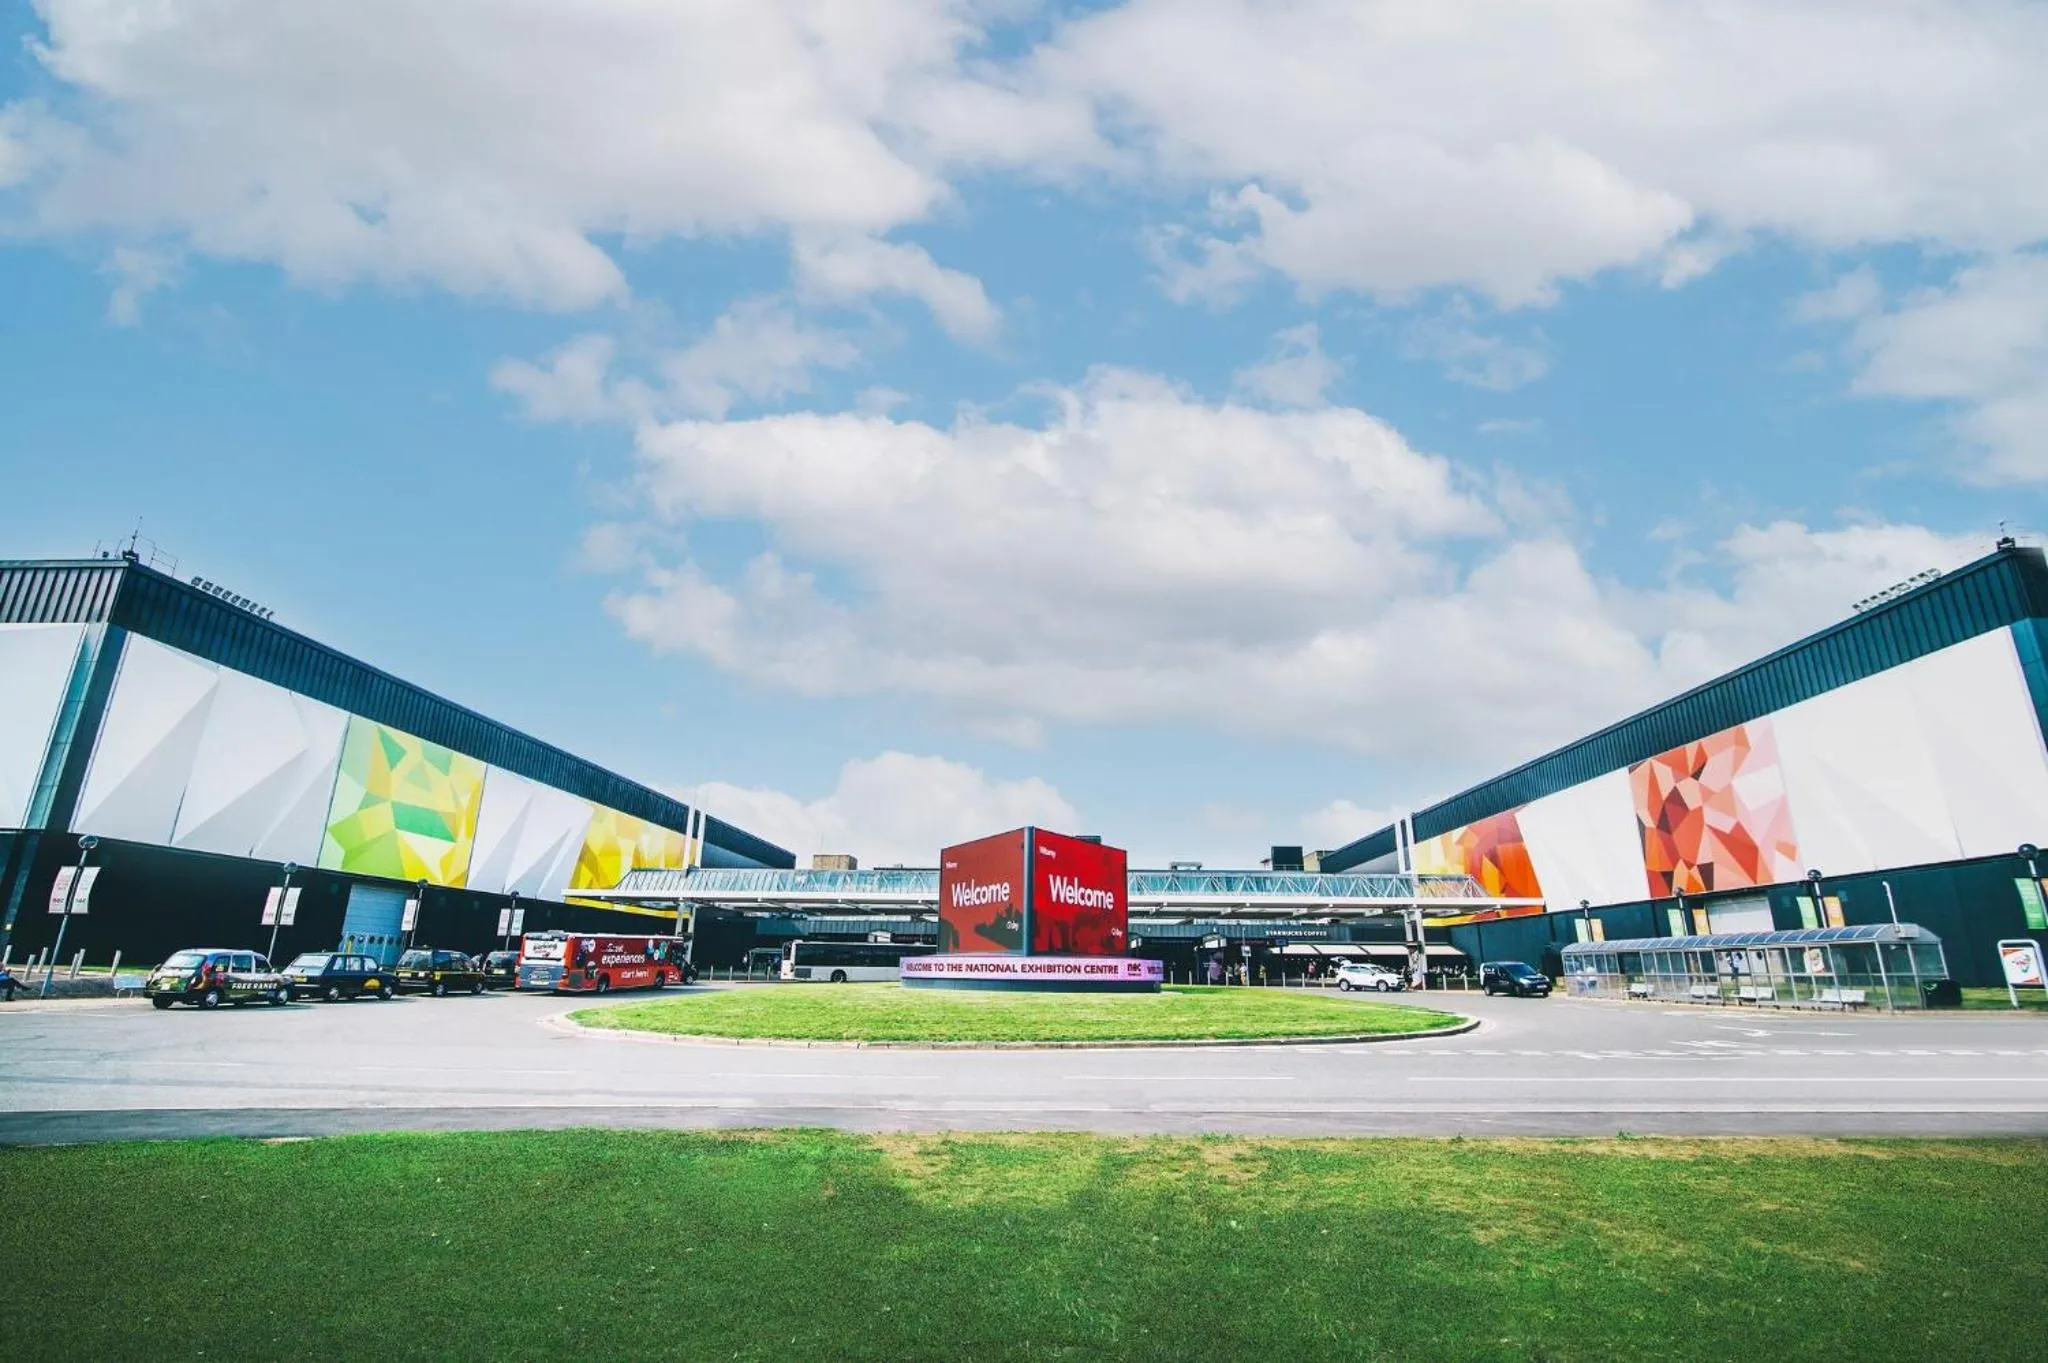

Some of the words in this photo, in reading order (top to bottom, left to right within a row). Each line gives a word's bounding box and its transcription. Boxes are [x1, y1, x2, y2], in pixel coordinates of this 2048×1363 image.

[951, 878, 1010, 908] Welcome
[1048, 873, 1114, 910] Welcome
[601, 953, 646, 968] experiences
[906, 962, 932, 972] WELCOME
[934, 963, 945, 972] TO
[946, 963, 963, 972] THE
[965, 963, 1018, 973] NATIONAL
[1021, 963, 1081, 974] EXHIBITION
[1084, 965, 1119, 975] CENTRE
